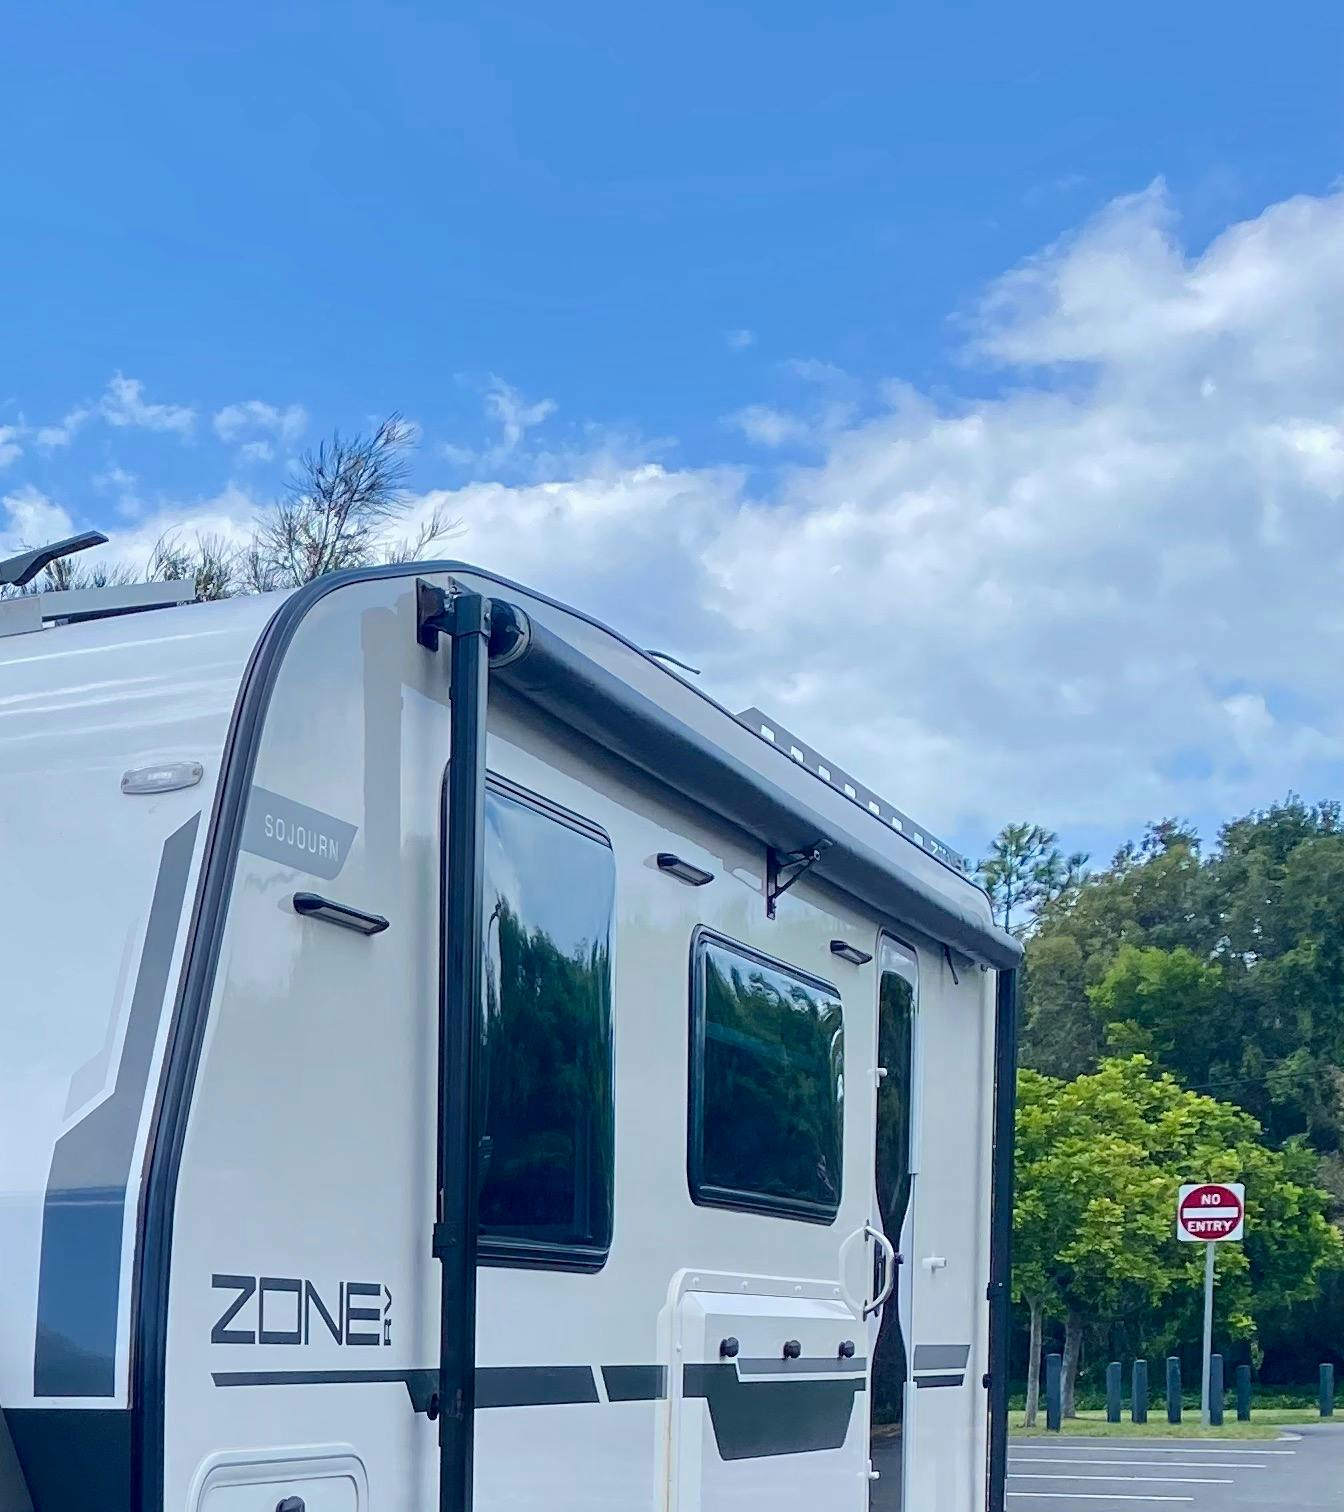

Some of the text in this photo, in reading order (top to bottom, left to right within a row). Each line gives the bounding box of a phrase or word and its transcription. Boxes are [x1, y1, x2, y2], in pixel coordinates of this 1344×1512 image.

[264, 812, 340, 863] SOJOURN
[1201, 1193, 1221, 1205] NO
[1187, 1220, 1234, 1232] ENTRY
[210, 1274, 393, 1347] ZONE RV
